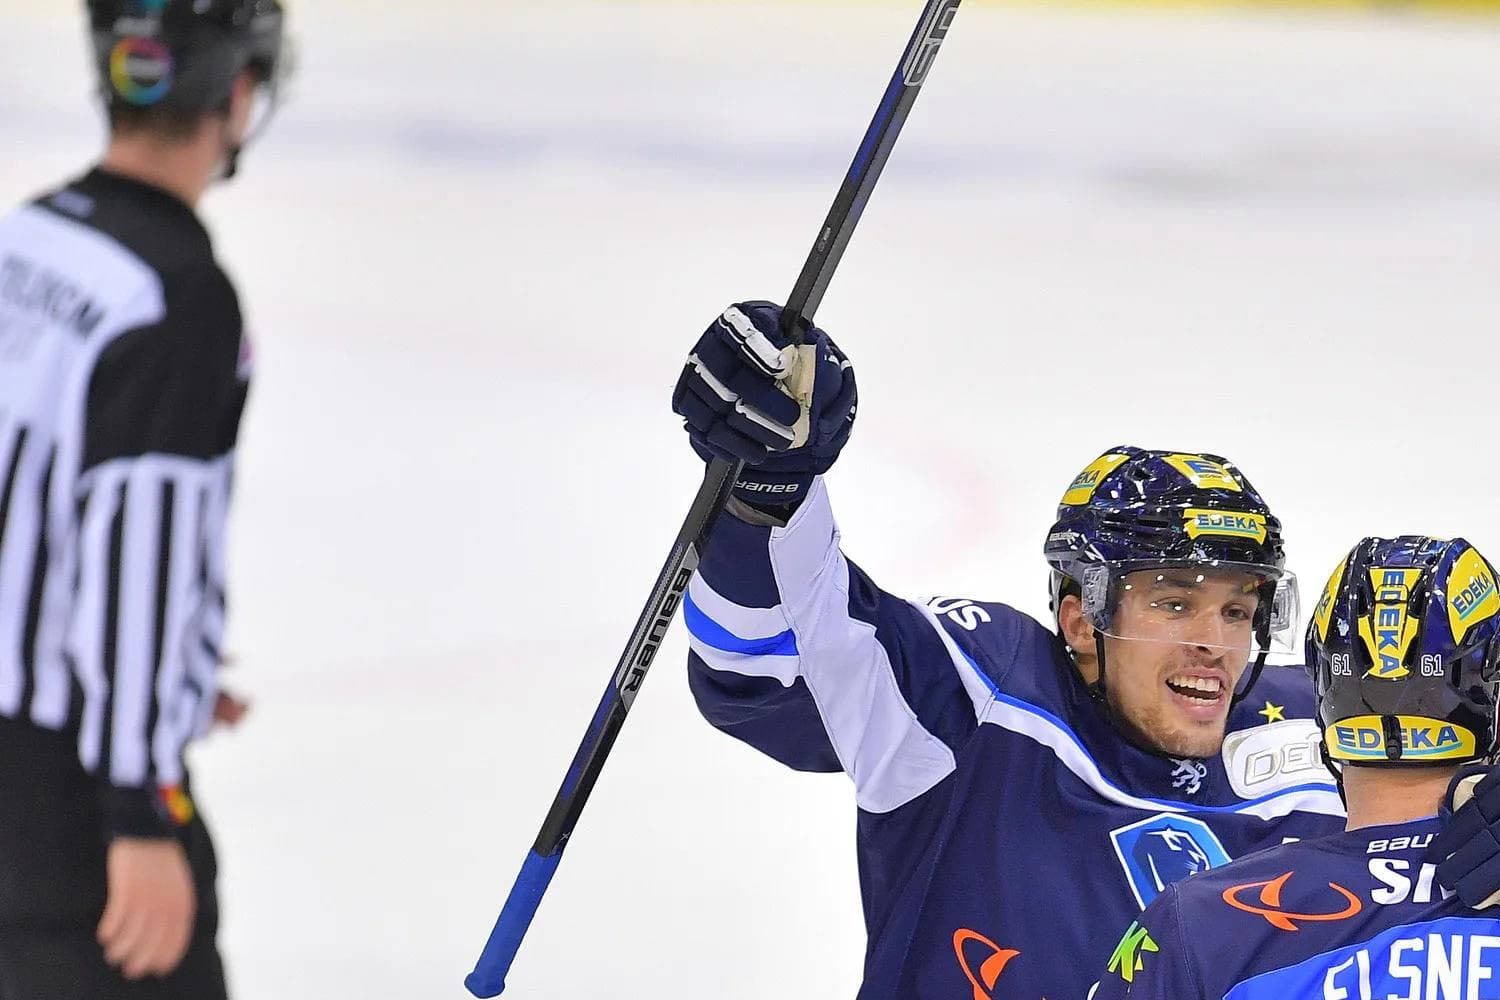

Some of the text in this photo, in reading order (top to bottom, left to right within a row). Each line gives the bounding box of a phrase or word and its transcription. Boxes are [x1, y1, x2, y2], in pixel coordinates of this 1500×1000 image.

[1198, 513, 1257, 531] EDEKA
[1450, 570, 1492, 615] EDEKA
[623, 567, 692, 693] BAUER
[1378, 570, 1405, 674] EDEKA
[1331, 653, 1352, 676] 61
[1420, 653, 1445, 677] 61
[1366, 832, 1440, 854] BAU
